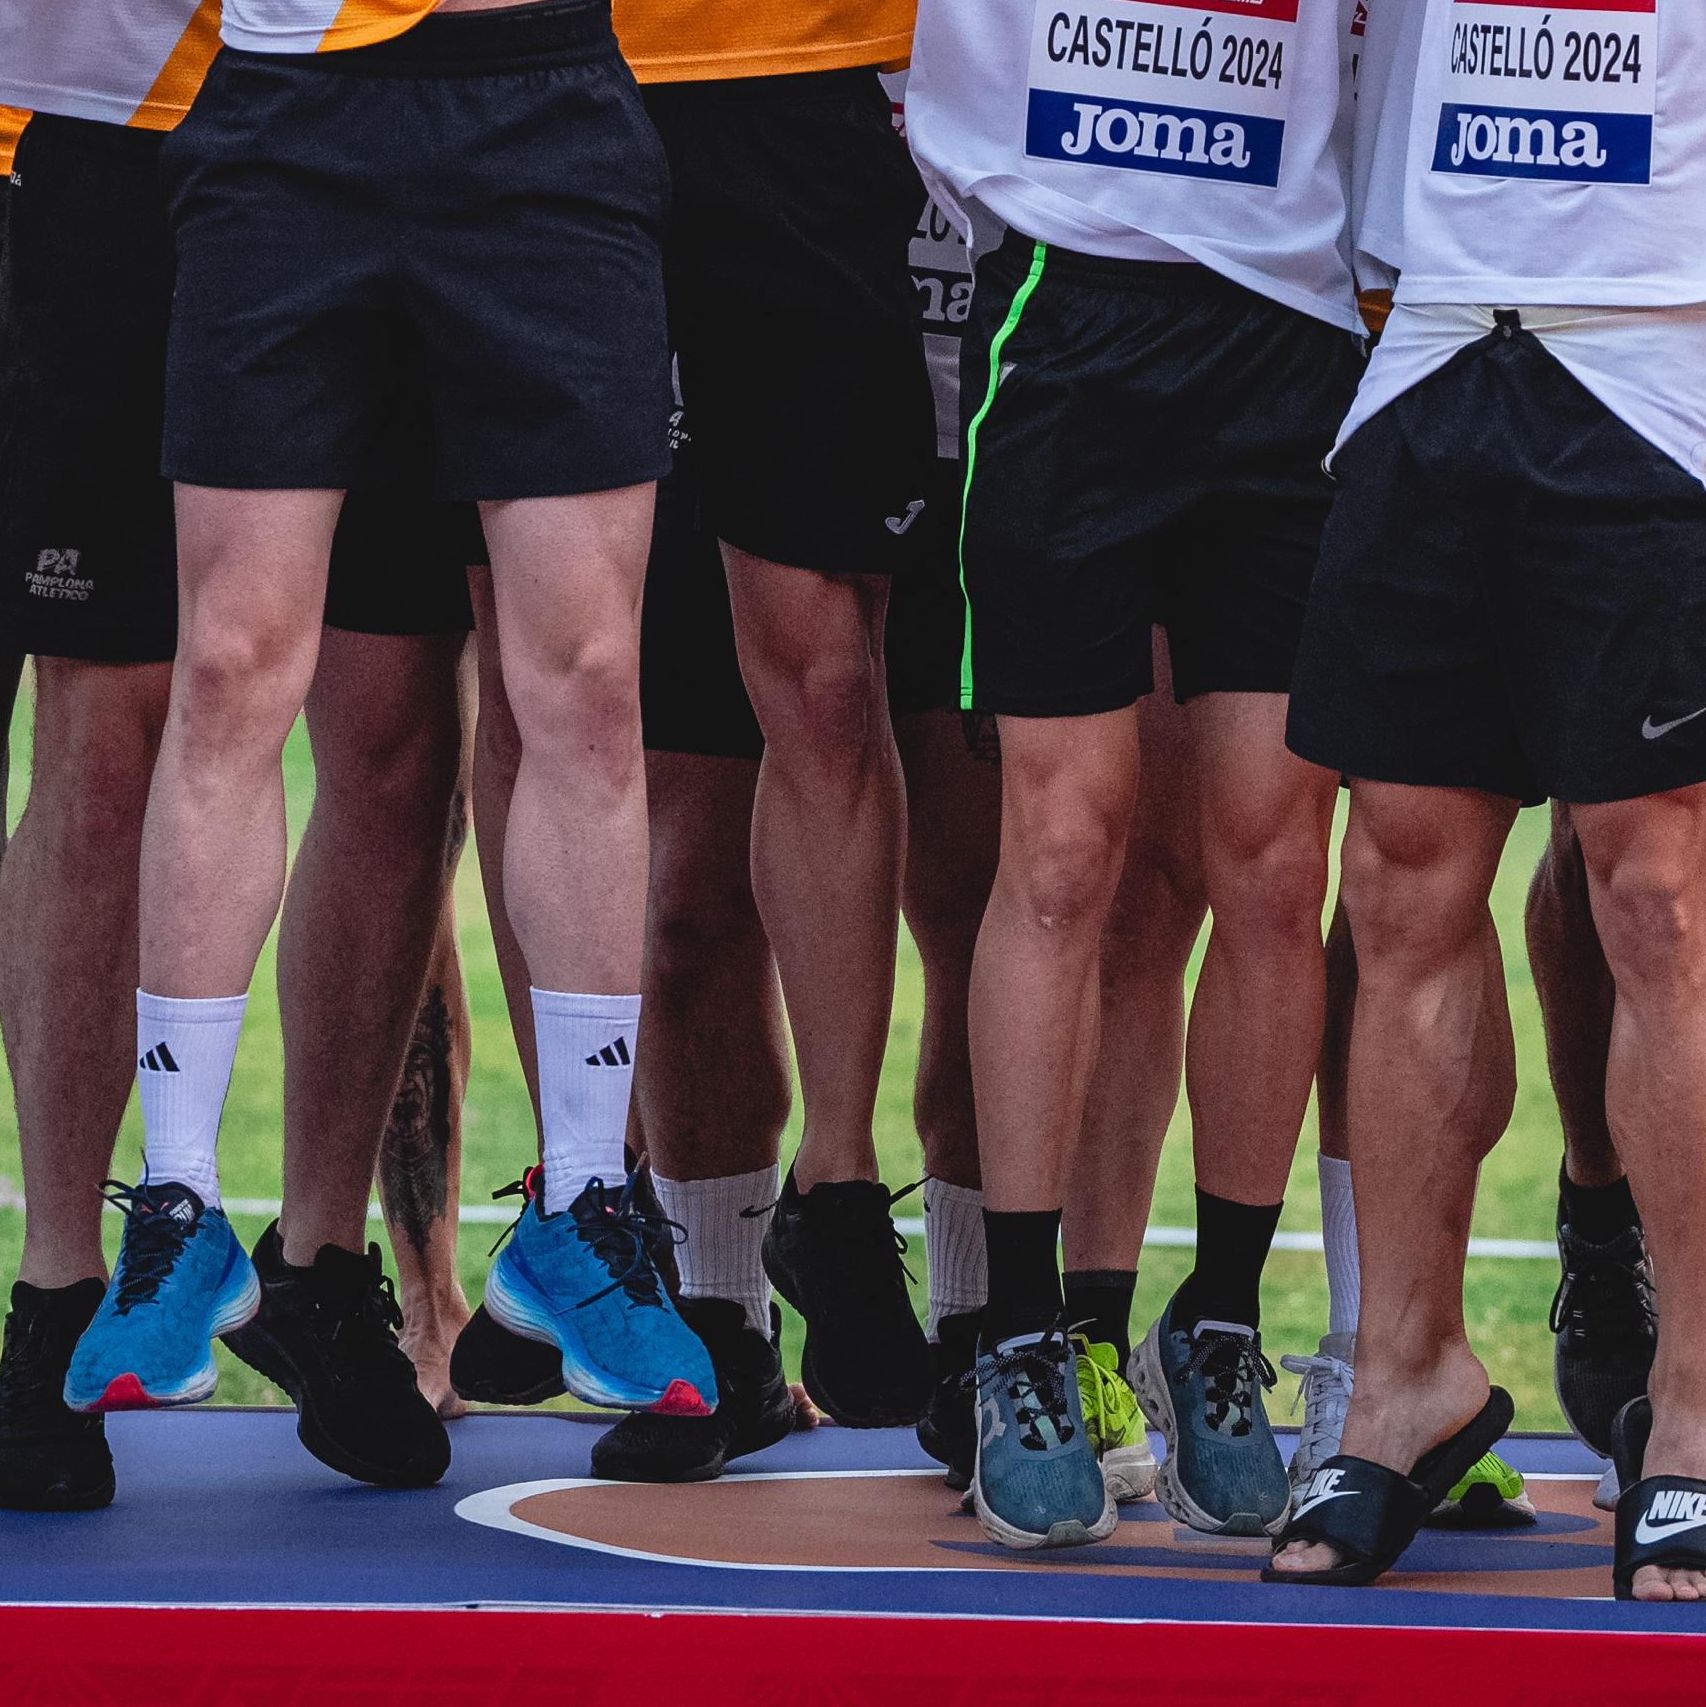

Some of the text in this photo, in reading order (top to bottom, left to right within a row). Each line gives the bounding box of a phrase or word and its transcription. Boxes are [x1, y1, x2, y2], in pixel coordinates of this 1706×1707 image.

[1048, 12, 1283, 90] CASTELLÓ 2024
[1451, 14, 1642, 84] CASTELLÓ 2024
[1061, 103, 1251, 169] Joma
[1450, 112, 1607, 169] Joma
